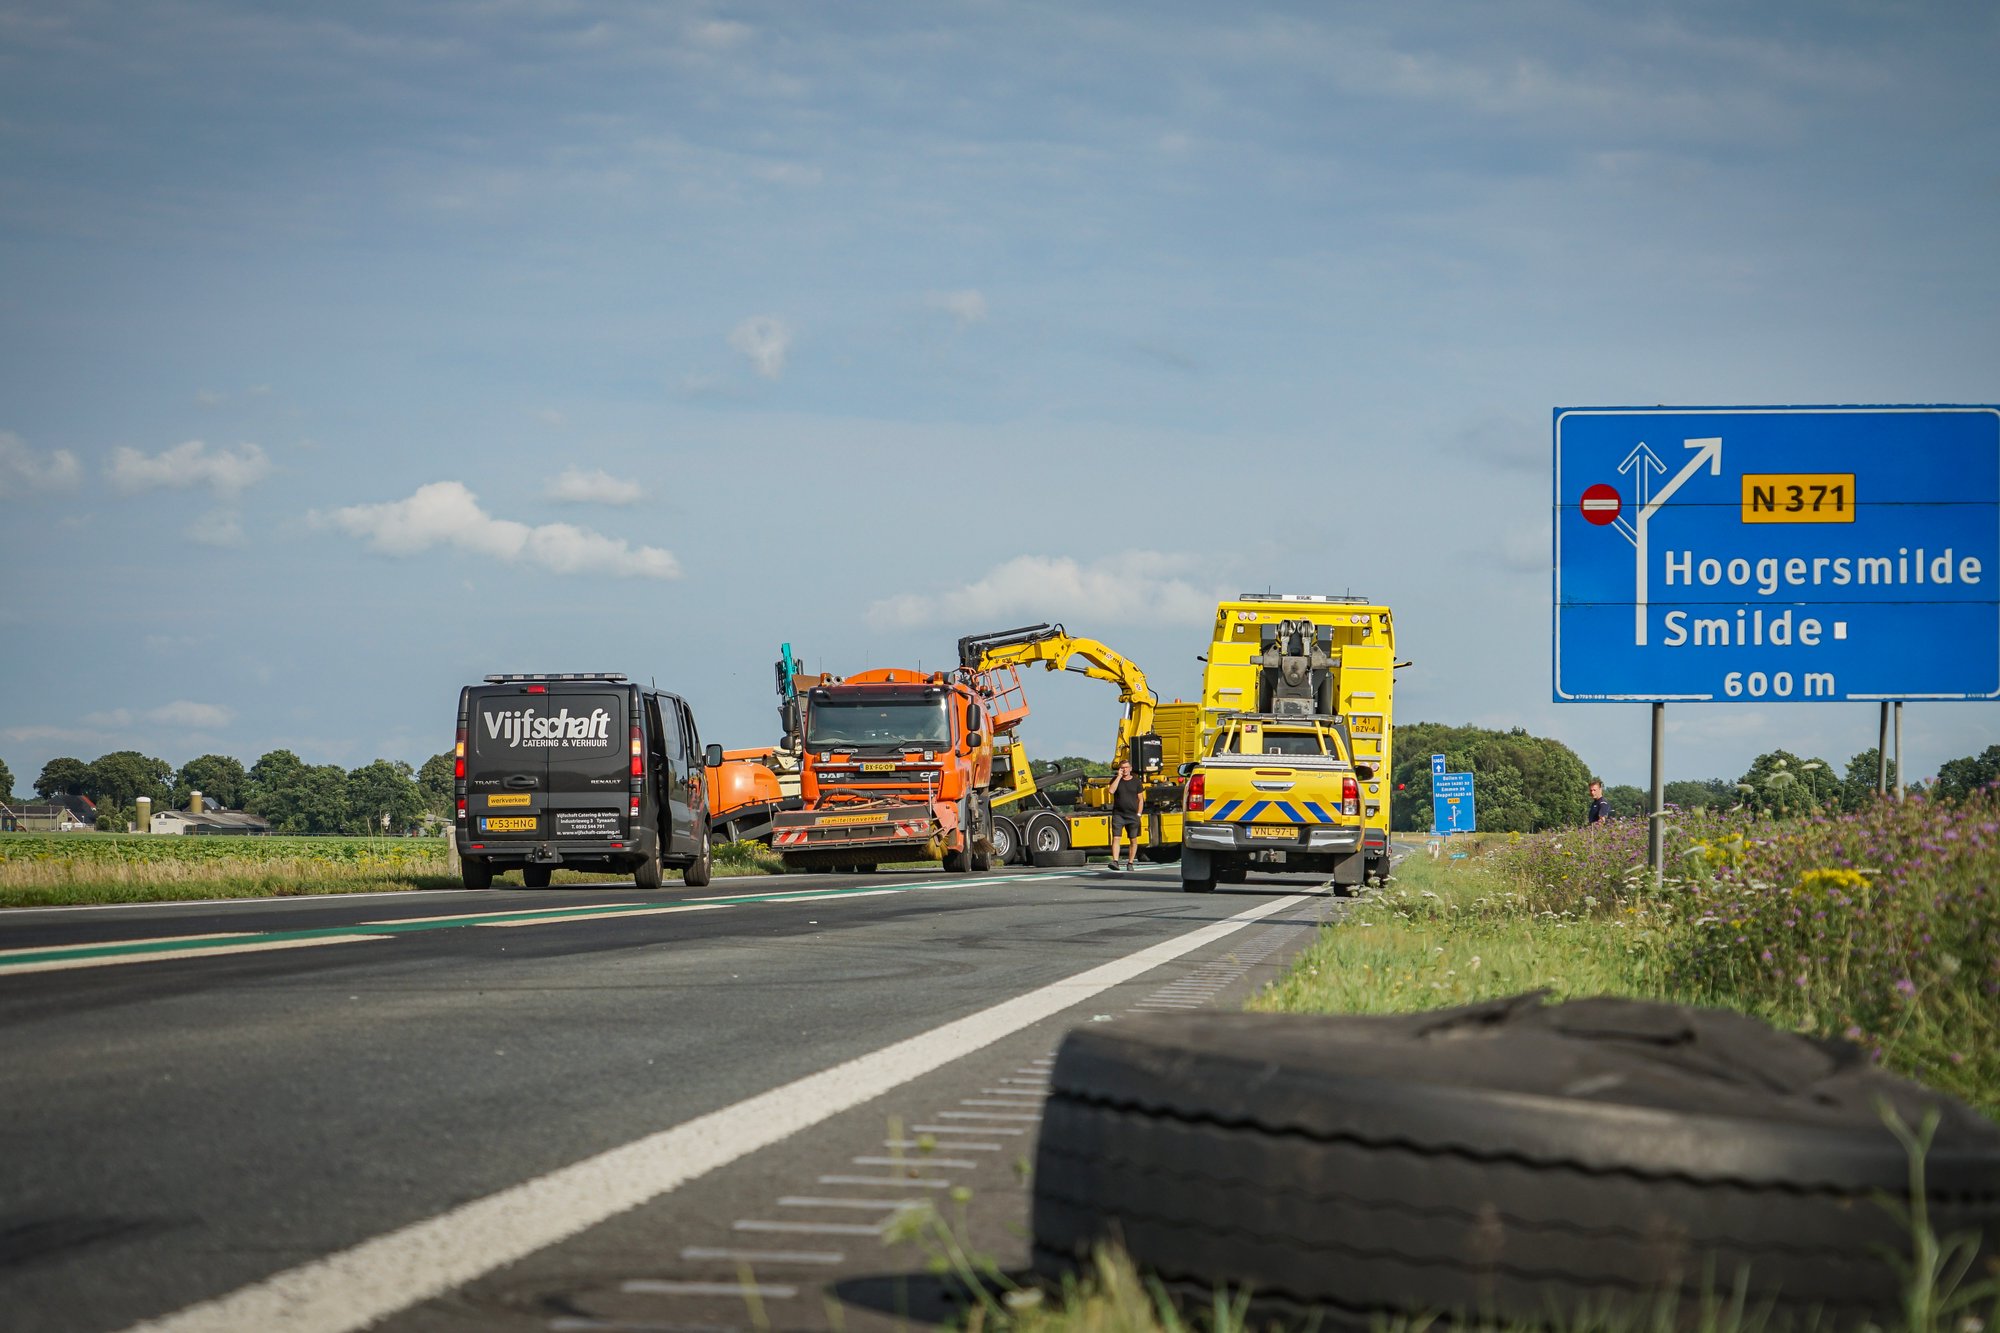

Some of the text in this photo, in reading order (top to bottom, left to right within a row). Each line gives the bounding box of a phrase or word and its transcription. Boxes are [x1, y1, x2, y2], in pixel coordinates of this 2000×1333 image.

[1752, 484, 1845, 512] N 371
[1664, 547, 1982, 596] Hoogersmilde
[1663, 610, 1823, 647] Smilde
[1724, 671, 1836, 698] 600 m
[483, 708, 611, 748] Vijfschaft
[522, 739, 608, 747] CATERING & VERHUUR
[865, 763, 894, 771] BX-FG-09
[488, 819, 534, 828] V-53-HNG
[1254, 827, 1295, 836] VNL-97-L
